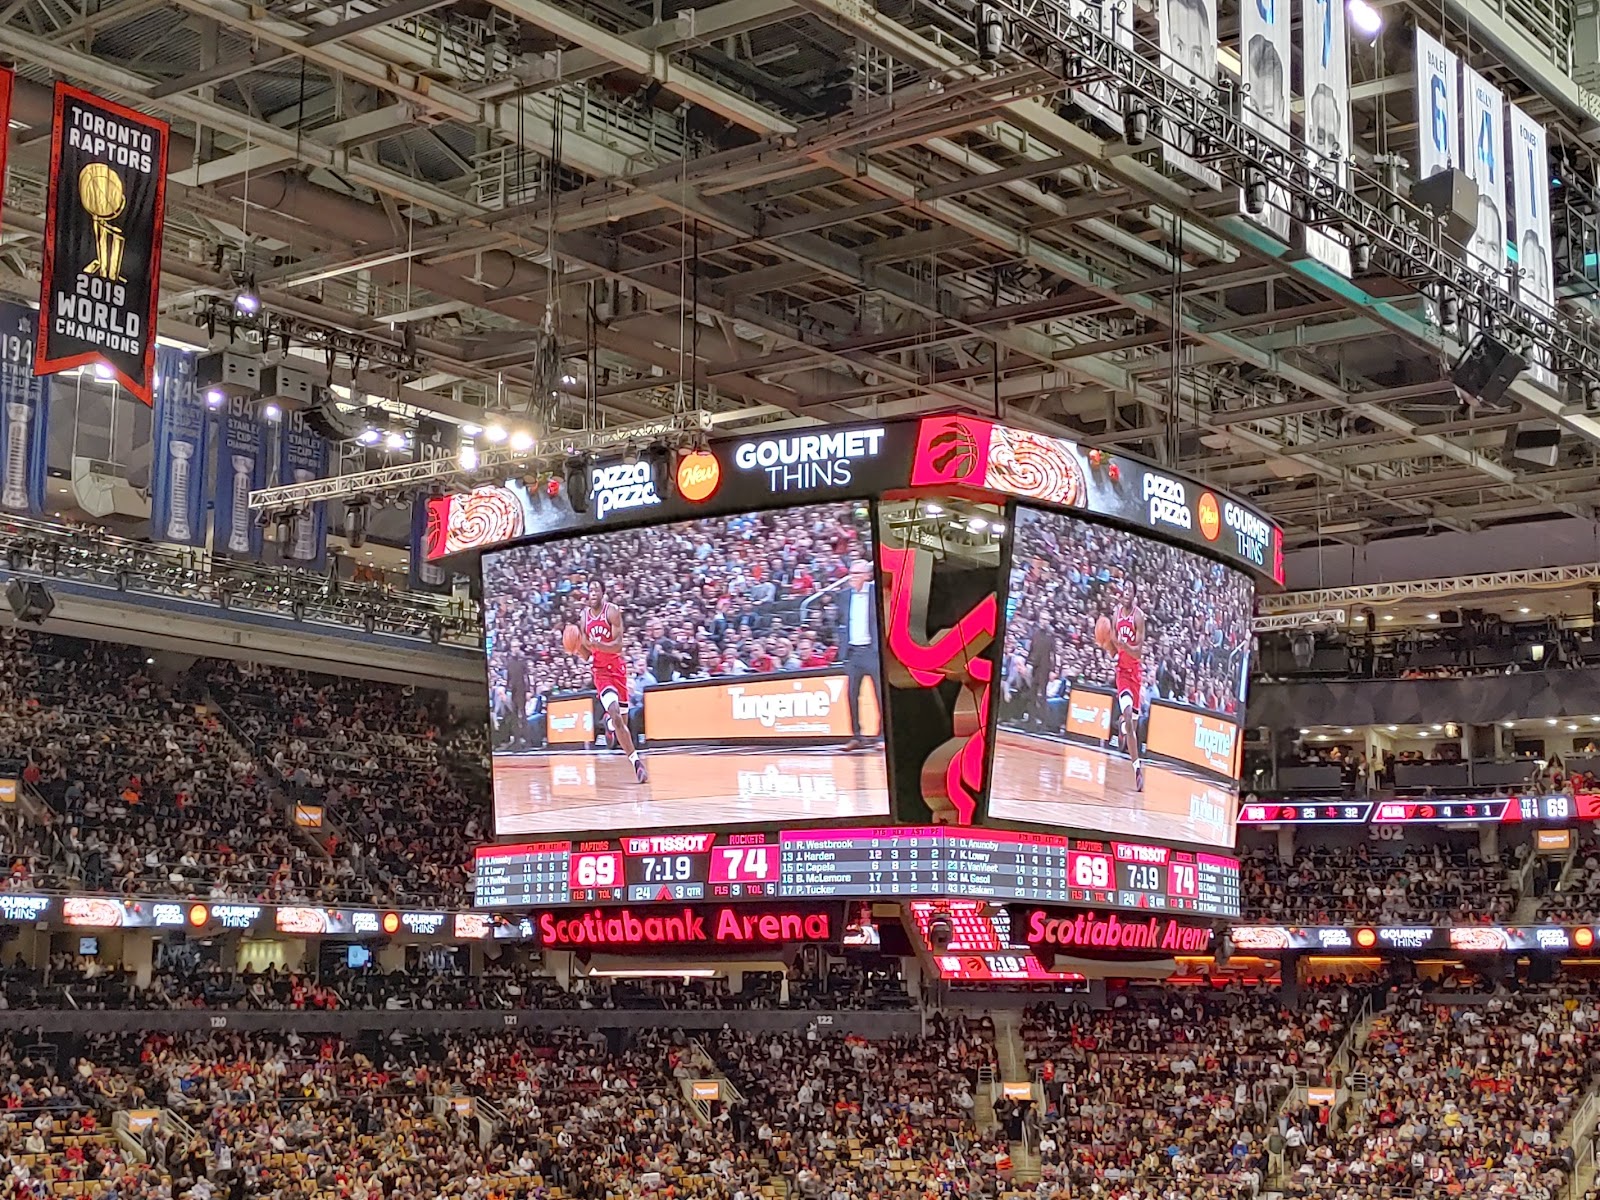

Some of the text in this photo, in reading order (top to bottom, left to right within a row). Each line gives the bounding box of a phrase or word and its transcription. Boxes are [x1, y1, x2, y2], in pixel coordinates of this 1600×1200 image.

[1431, 74, 1448, 152] 6
[72, 106, 152, 152] TORONTO
[69, 128, 152, 174] RAPTORS
[1478, 110, 1494, 184] 4
[1528, 146, 1537, 218] 1
[76, 273, 126, 306] 2019
[58, 291, 140, 338] WORLD
[56, 318, 140, 356] CHAMPIONS
[2, 333, 36, 365] 194
[735, 428, 885, 469] GOURMET
[590, 461, 651, 500] pizza
[682, 462, 718, 488] New
[764, 458, 852, 492] THINS
[1143, 472, 1186, 506] pizza
[1150, 496, 1192, 530] pizza
[1224, 502, 1270, 547] GOURMET
[1236, 530, 1263, 566] THINS
[1546, 798, 1568, 817] 69
[729, 834, 765, 845] ROCKETS
[1368, 824, 1404, 841] 302
[580, 841, 610, 852] RAPTORS
[649, 834, 708, 854] TISSOT
[784, 841, 792, 850] 0
[806, 839, 853, 849] Westbrook
[891, 838, 898, 847] 7
[931, 838, 938, 846] 1
[1046, 845, 1051, 854] 1
[1060, 846, 1065, 856] 2
[804, 851, 836, 860] Harden
[869, 850, 882, 860] 12
[890, 850, 899, 860] 3
[931, 849, 939, 858] 2
[950, 850, 956, 858] 7
[1015, 854, 1025, 864] 11
[1060, 858, 1066, 867] 2
[1132, 846, 1167, 863] TISSOT
[578, 855, 615, 886] 69
[642, 856, 690, 882] 7:19
[722, 848, 768, 880] 74
[782, 863, 794, 872] 15
[806, 862, 836, 873] Capela
[910, 861, 918, 870] 2
[931, 860, 939, 870] 2
[1076, 855, 1108, 887] 69
[806, 873, 852, 882] McLemore
[869, 872, 882, 882] 17
[892, 872, 898, 881] 1
[910, 872, 918, 881] 1
[932, 872, 938, 880] 1
[948, 872, 958, 880] 33
[1017, 876, 1024, 886] 0
[1060, 880, 1066, 889] 2
[1127, 864, 1158, 890] 7:19
[1174, 865, 1195, 894] 74
[587, 890, 593, 900] 1
[614, 888, 621, 899] 4
[636, 887, 650, 900] 24
[676, 886, 700, 899] 3 QTR
[714, 884, 740, 896] FLS 3
[746, 883, 774, 894] TOL 5
[782, 886, 792, 894] 17
[796, 886, 804, 894] P.
[806, 885, 836, 894] Tucker
[869, 884, 882, 893] 11
[930, 883, 939, 892] 4
[1015, 888, 1025, 897] 20
[1032, 889, 1038, 898] 7
[1060, 890, 1066, 900] 2
[1084, 890, 1090, 901] 1
[1149, 895, 1156, 907] 3
[1178, 898, 1184, 908] 3
[4, 908, 36, 920] THINS
[212, 905, 260, 918] GOURMET
[222, 916, 250, 928] THINS
[411, 924, 435, 934] THINS
[540, 908, 706, 944] Scotiabank
[716, 908, 830, 940] Arena
[1028, 911, 1160, 948] Scotiabank
[1161, 920, 1210, 951] Arena
[1380, 928, 1433, 939] GOURMET
[1392, 938, 1423, 948] THINS
[985, 956, 1018, 972] 7:19
[210, 1016, 226, 1028] 120
[504, 1016, 517, 1024] 121
[816, 1016, 833, 1024] 122
